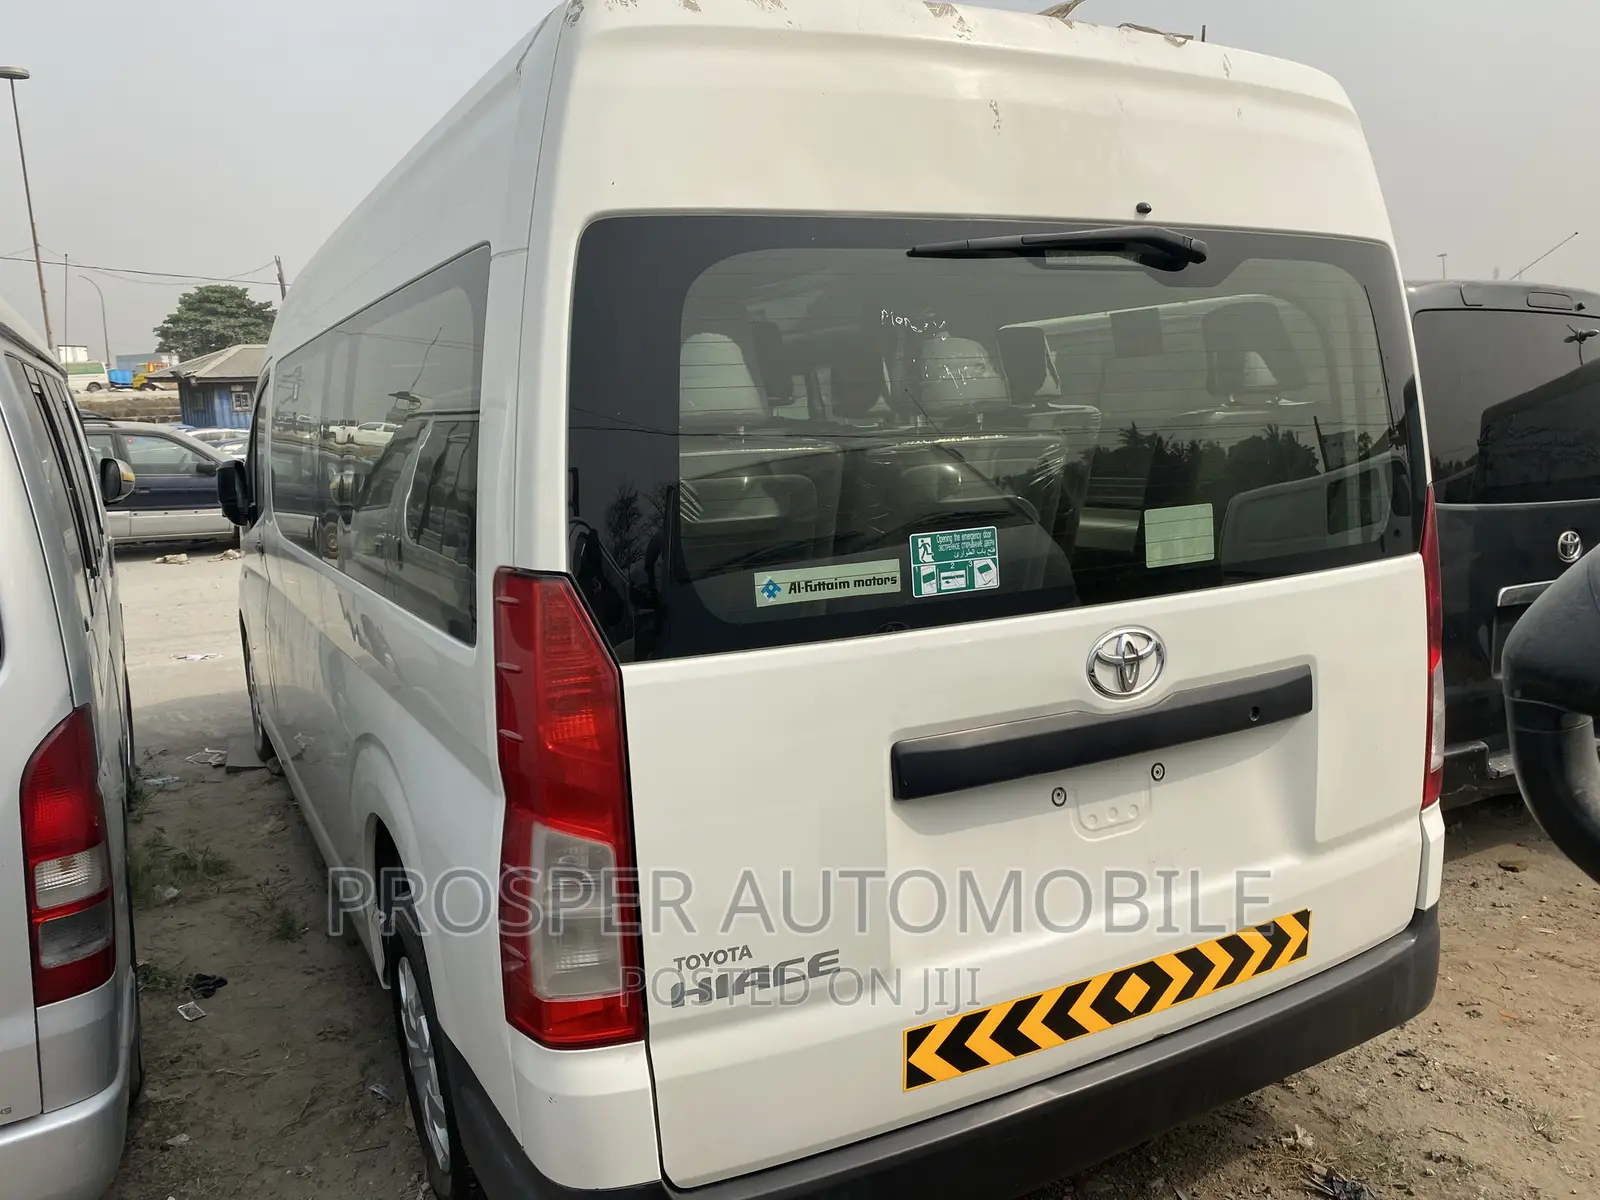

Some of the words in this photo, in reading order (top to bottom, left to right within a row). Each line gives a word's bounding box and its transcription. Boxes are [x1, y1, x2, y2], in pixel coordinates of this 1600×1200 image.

[936, 534, 953, 544] Opening
[961, 531, 982, 542] emergency
[983, 530, 992, 539] door
[788, 578, 850, 595] Al-Futtaim
[853, 575, 898, 589] motors
[673, 945, 753, 973] TOYOTA
[671, 949, 841, 1008] HIACE
